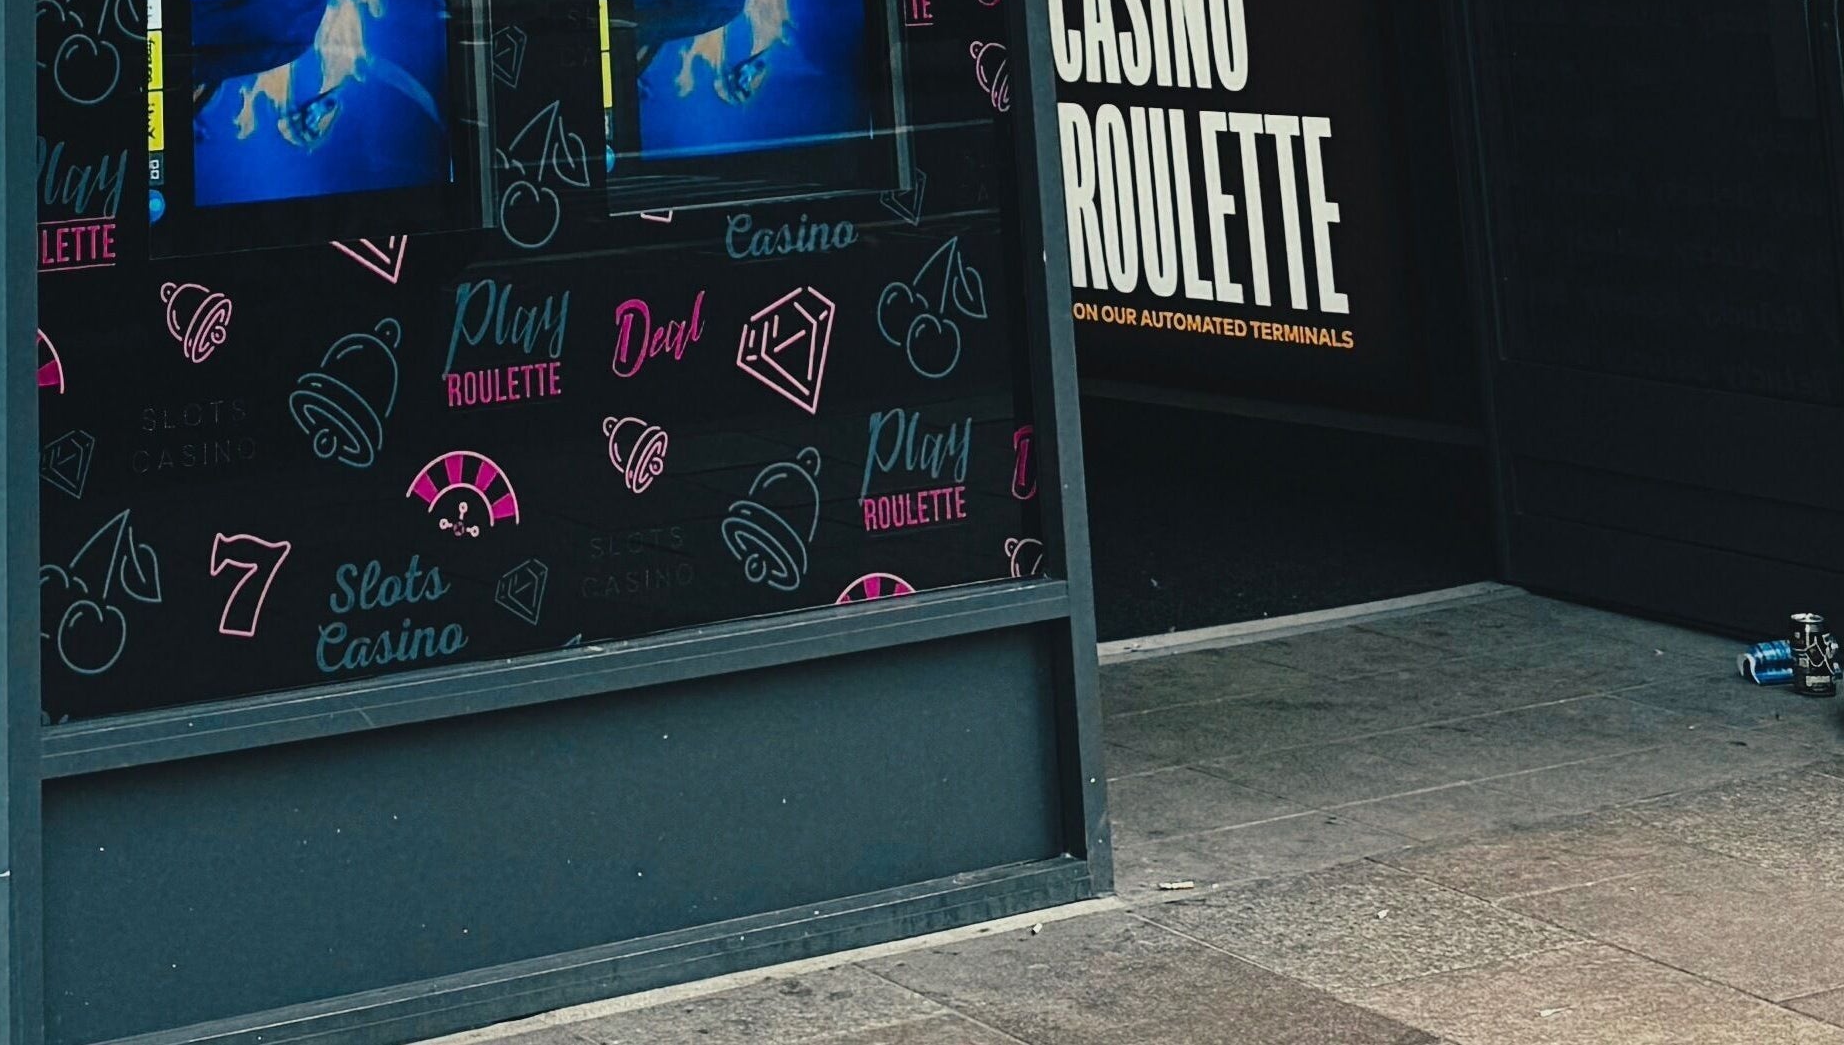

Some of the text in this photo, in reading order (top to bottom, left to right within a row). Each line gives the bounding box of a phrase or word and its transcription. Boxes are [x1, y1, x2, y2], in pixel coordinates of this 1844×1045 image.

[36, 136, 129, 217] lay
[725, 211, 859, 259] Casino
[1056, 102, 1351, 315] ROULETTE
[40, 223, 117, 266] LETTE
[442, 278, 572, 381] Play
[611, 289, 707, 378] Deal
[1072, 302, 1355, 349] ON OUR AUTOMATED TERMINALS
[446, 360, 564, 408] ROULETTE
[858, 407, 973, 507] Play
[862, 485, 968, 532] ROULETTE
[329, 553, 452, 614] Slots
[314, 616, 469, 674] Casino
